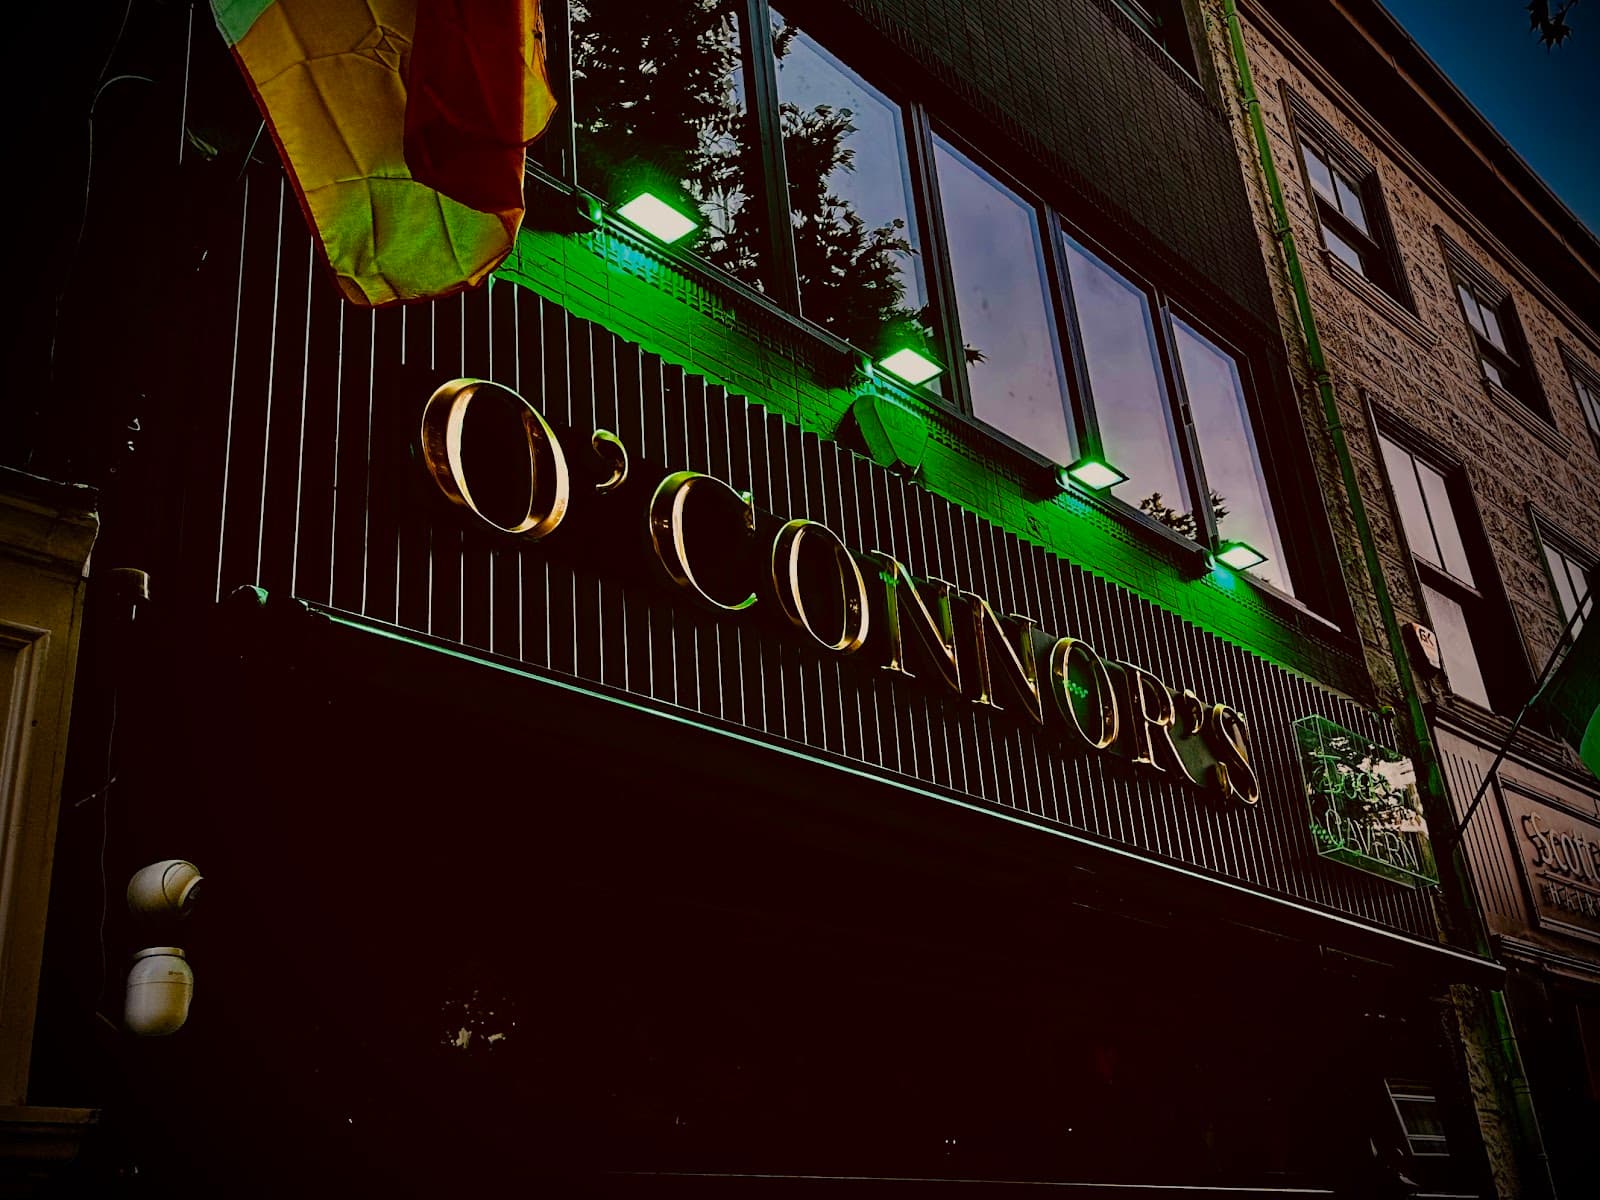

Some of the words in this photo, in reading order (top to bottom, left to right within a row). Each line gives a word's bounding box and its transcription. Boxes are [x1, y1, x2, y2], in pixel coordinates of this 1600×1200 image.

[421, 377, 1259, 806] O'CONNOR'S
[1523, 811, 1600, 882] Scott
[1544, 880, 1600, 918] HAIR
